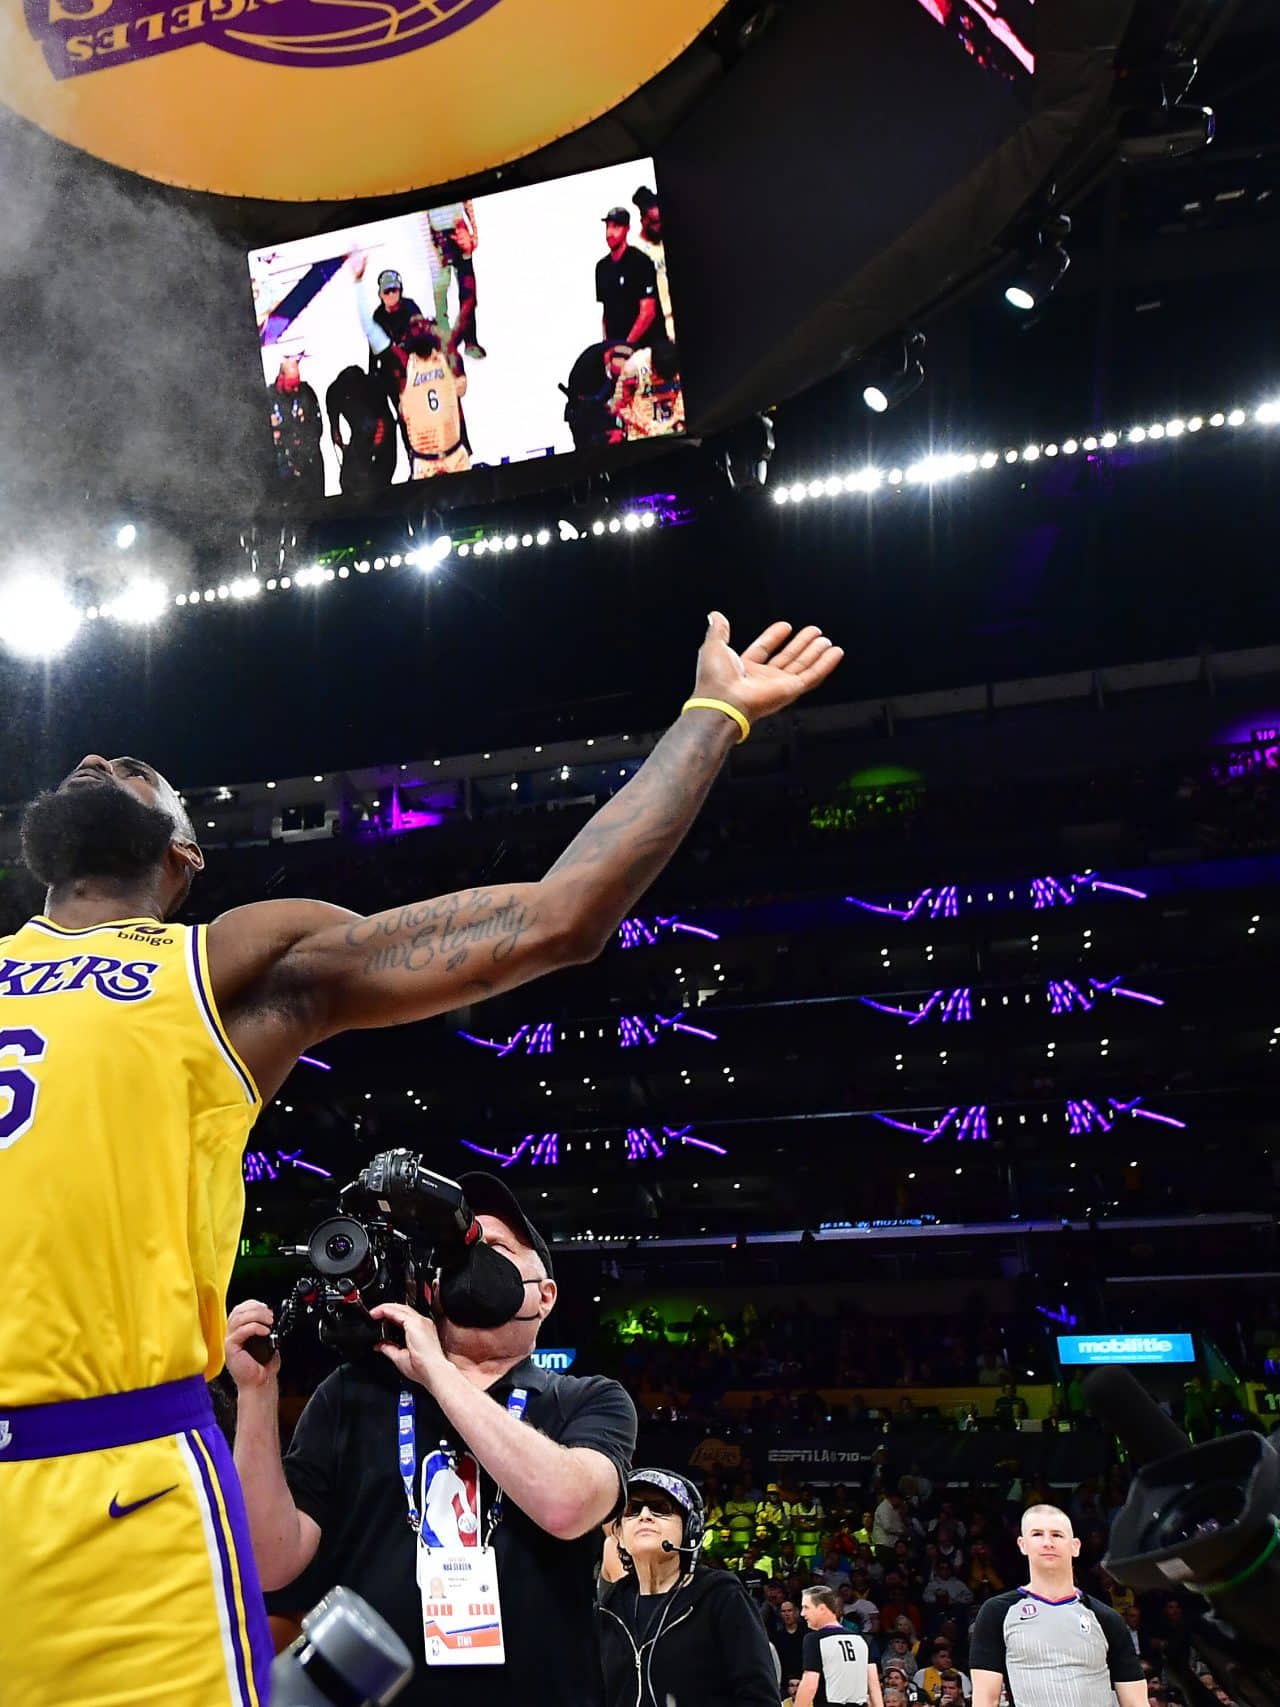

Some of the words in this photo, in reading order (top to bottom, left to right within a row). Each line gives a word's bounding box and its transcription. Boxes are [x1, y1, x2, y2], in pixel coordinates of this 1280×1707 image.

[427, 388, 439, 411] 6
[116, 931, 174, 947] bibigo
[1077, 1337, 1174, 1353] mobilitie
[838, 1640, 856, 1661] 16
